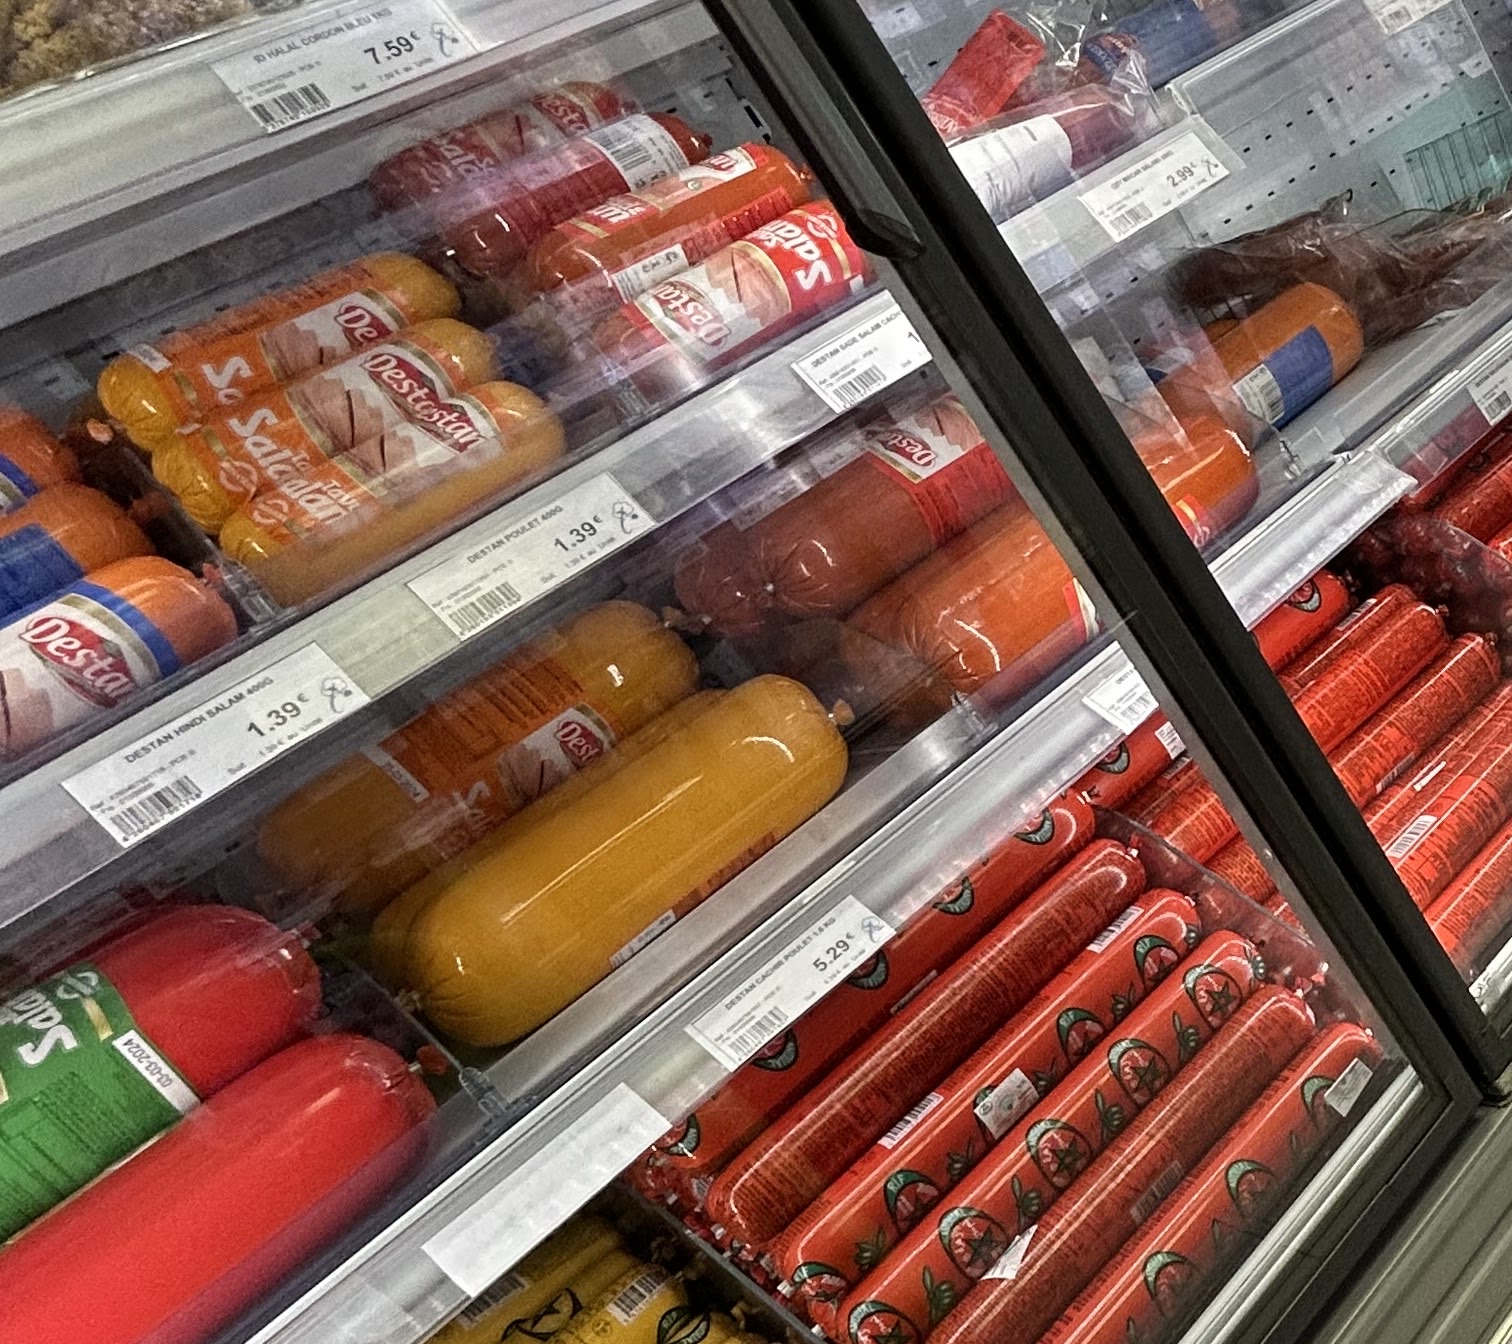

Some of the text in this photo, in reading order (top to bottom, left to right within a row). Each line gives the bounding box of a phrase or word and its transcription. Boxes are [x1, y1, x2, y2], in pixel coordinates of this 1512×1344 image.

[264, 40, 299, 60] HALAL
[300, 25, 343, 47] CORDON
[466, 537, 505, 564] DESTAN
[504, 516, 542, 543] POULET
[124, 731, 175, 764] DESTAN
[173, 714, 208, 738] HINDI
[206, 691, 247, 720] SALAM
[724, 983, 757, 1011] DESTAN
[783, 936, 813, 963] POULET
